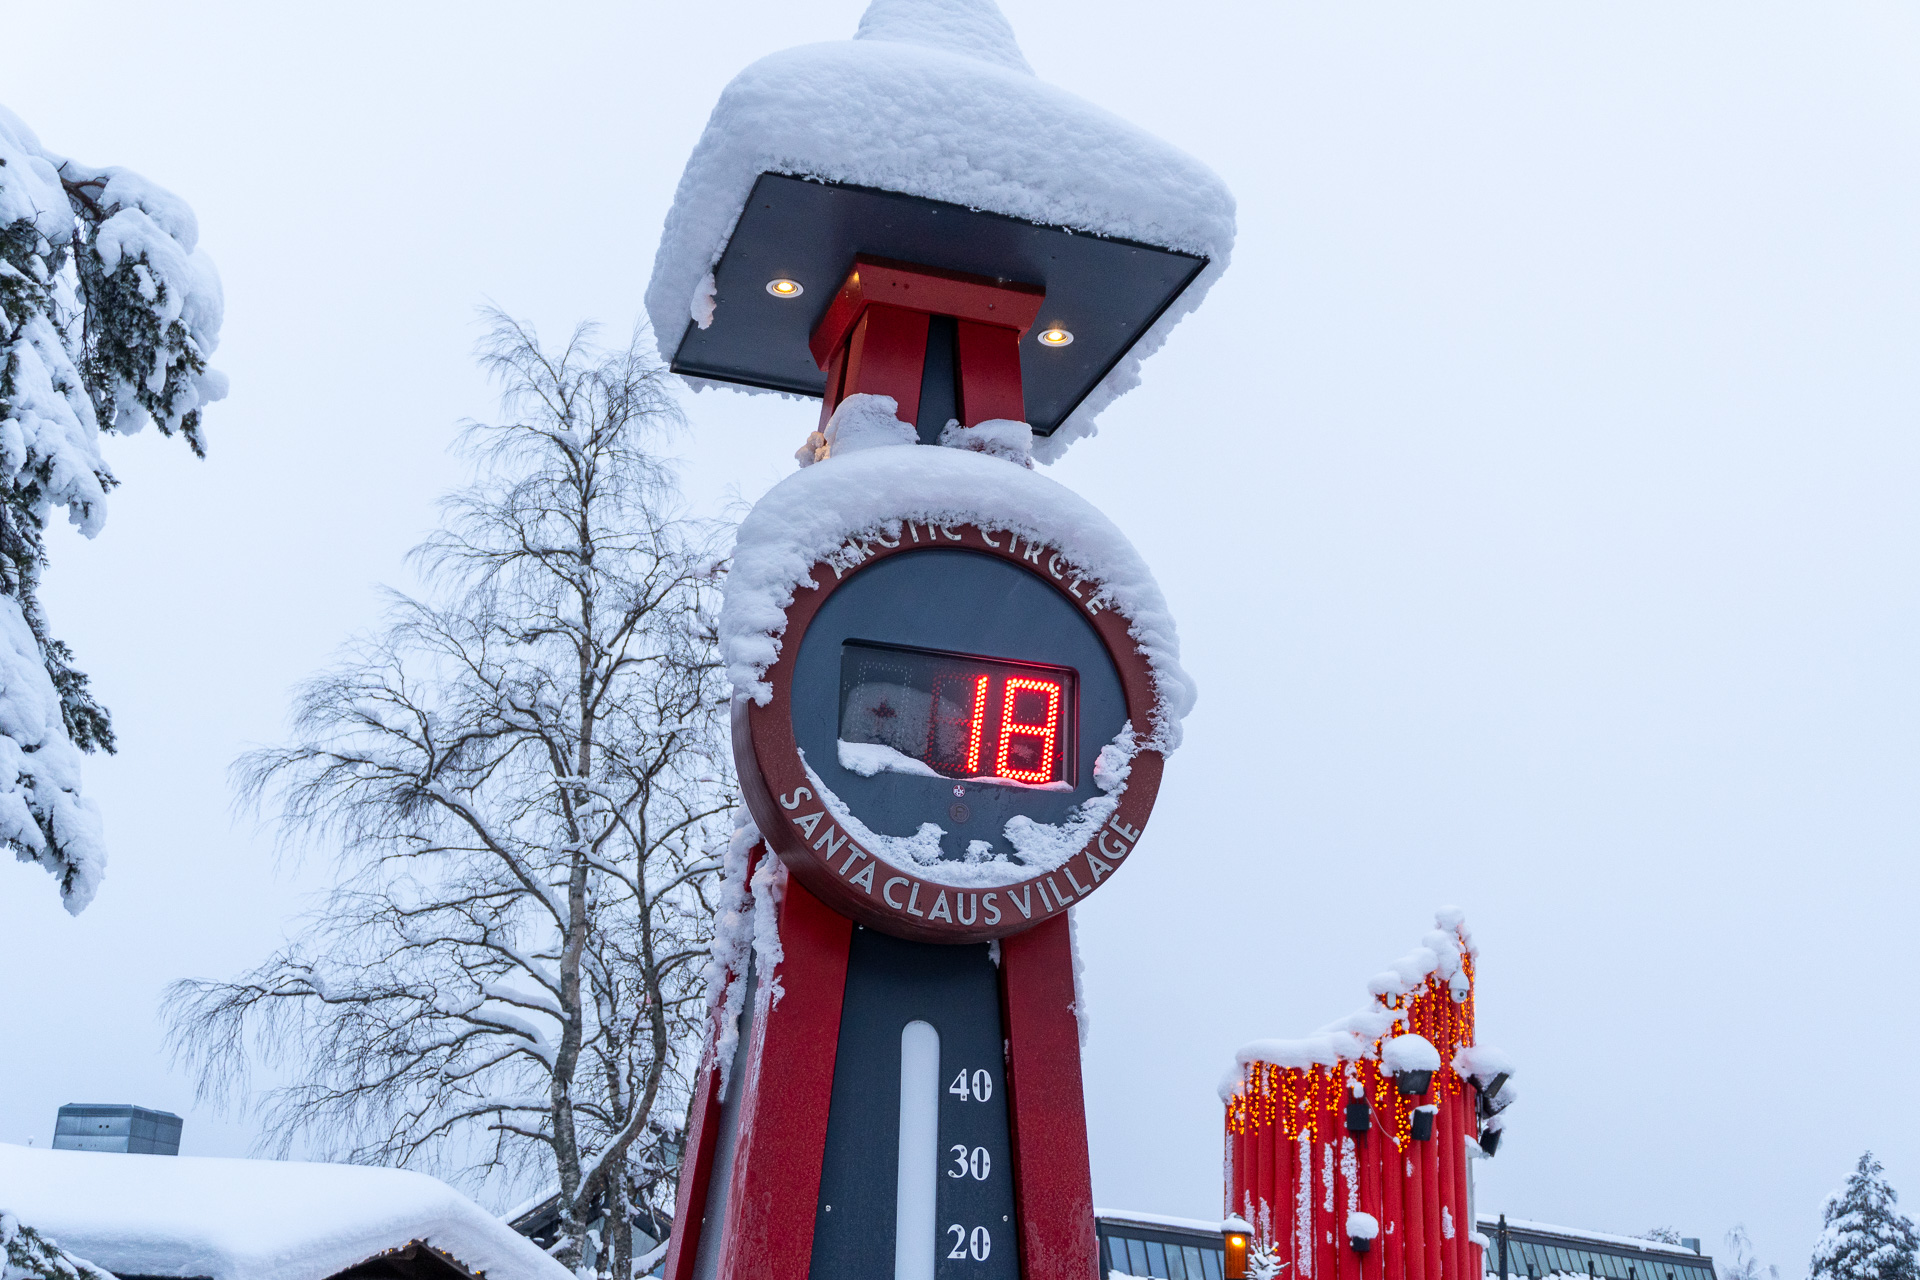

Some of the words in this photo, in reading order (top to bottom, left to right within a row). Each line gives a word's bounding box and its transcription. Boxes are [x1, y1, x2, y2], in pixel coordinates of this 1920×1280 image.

[966, 674, 1061, 783] 18
[779, 785, 877, 896] SANTA
[882, 875, 1002, 926] CLAUS
[1006, 812, 1141, 919] VILLAGE
[949, 1068, 993, 1102] 40
[947, 1144, 991, 1181] 30
[946, 1223, 991, 1262] 20
